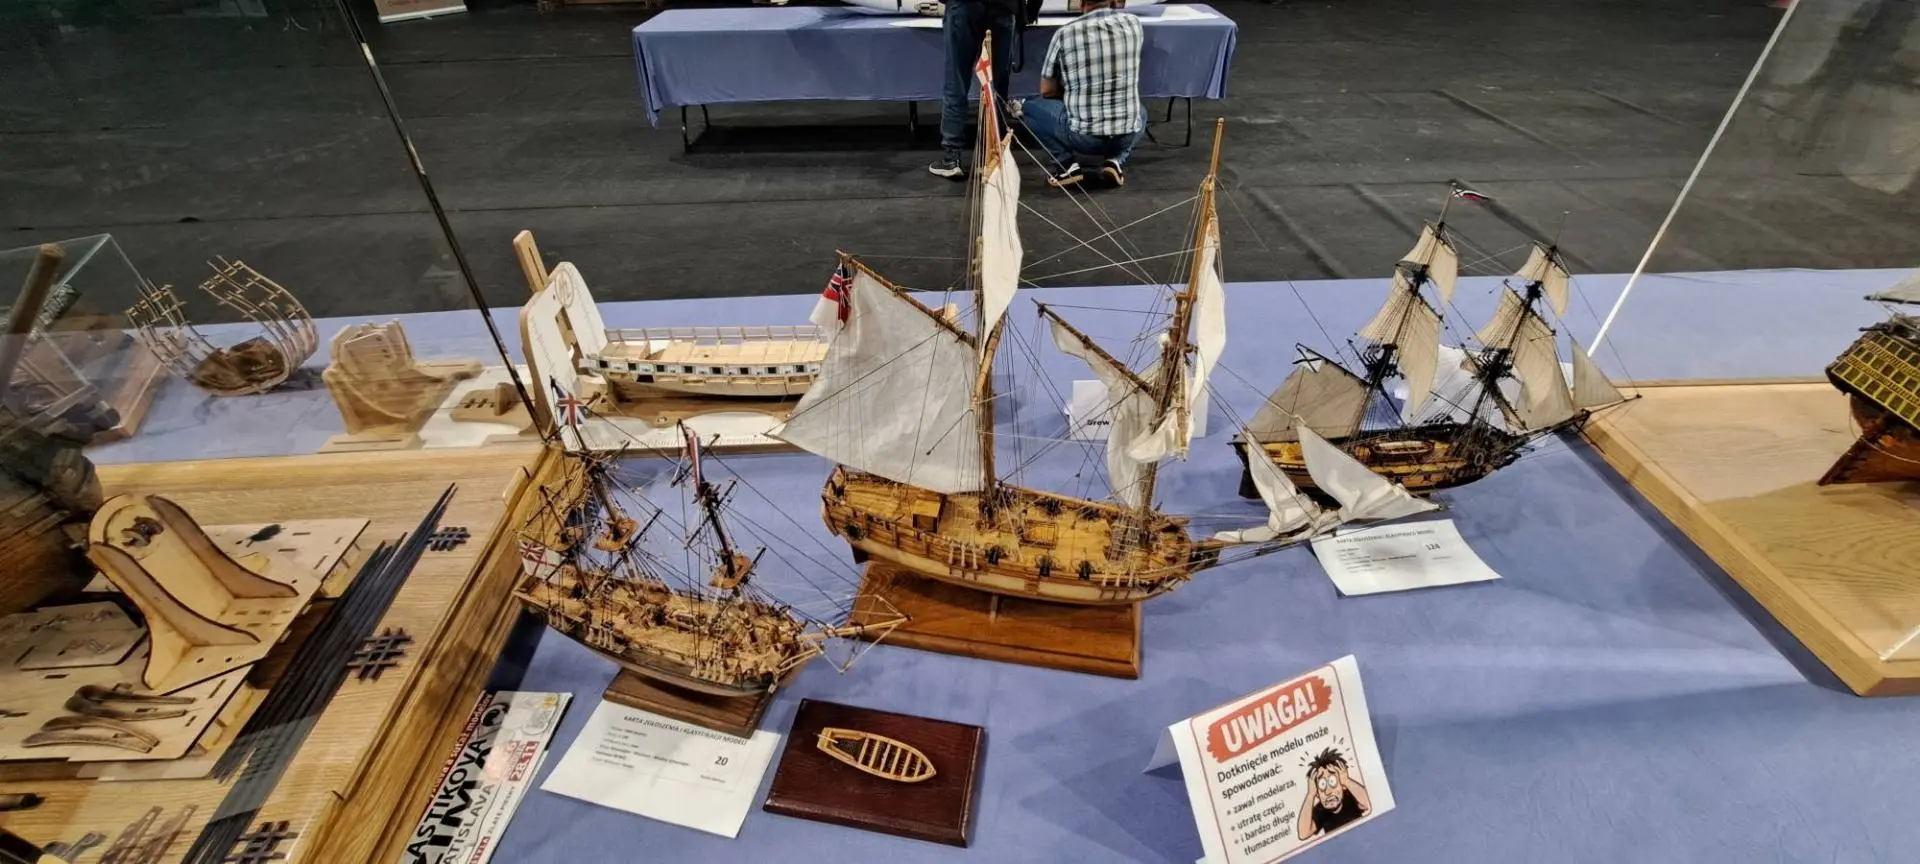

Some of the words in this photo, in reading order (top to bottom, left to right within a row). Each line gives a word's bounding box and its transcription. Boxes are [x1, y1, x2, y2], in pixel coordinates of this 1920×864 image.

[1221, 681, 1317, 752] UWAGA!
[714, 755, 729, 766] 20
[1217, 753, 1268, 783] Dotknięcie
[1270, 737, 1304, 759] modelu
[1305, 725, 1329, 743] może
[1222, 762, 1283, 800] spowodować:
[1233, 796, 1255, 814] zawał
[1256, 779, 1297, 802] modelarza,
[407, 739, 487, 864] ASTIKOVA
[1237, 812, 1261, 830] utratę
[1263, 800, 1285, 817] części
[1244, 826, 1292, 856] tłumaczenie!
[1245, 823, 1271, 841] bardzo
[1272, 810, 1296, 828] długie
